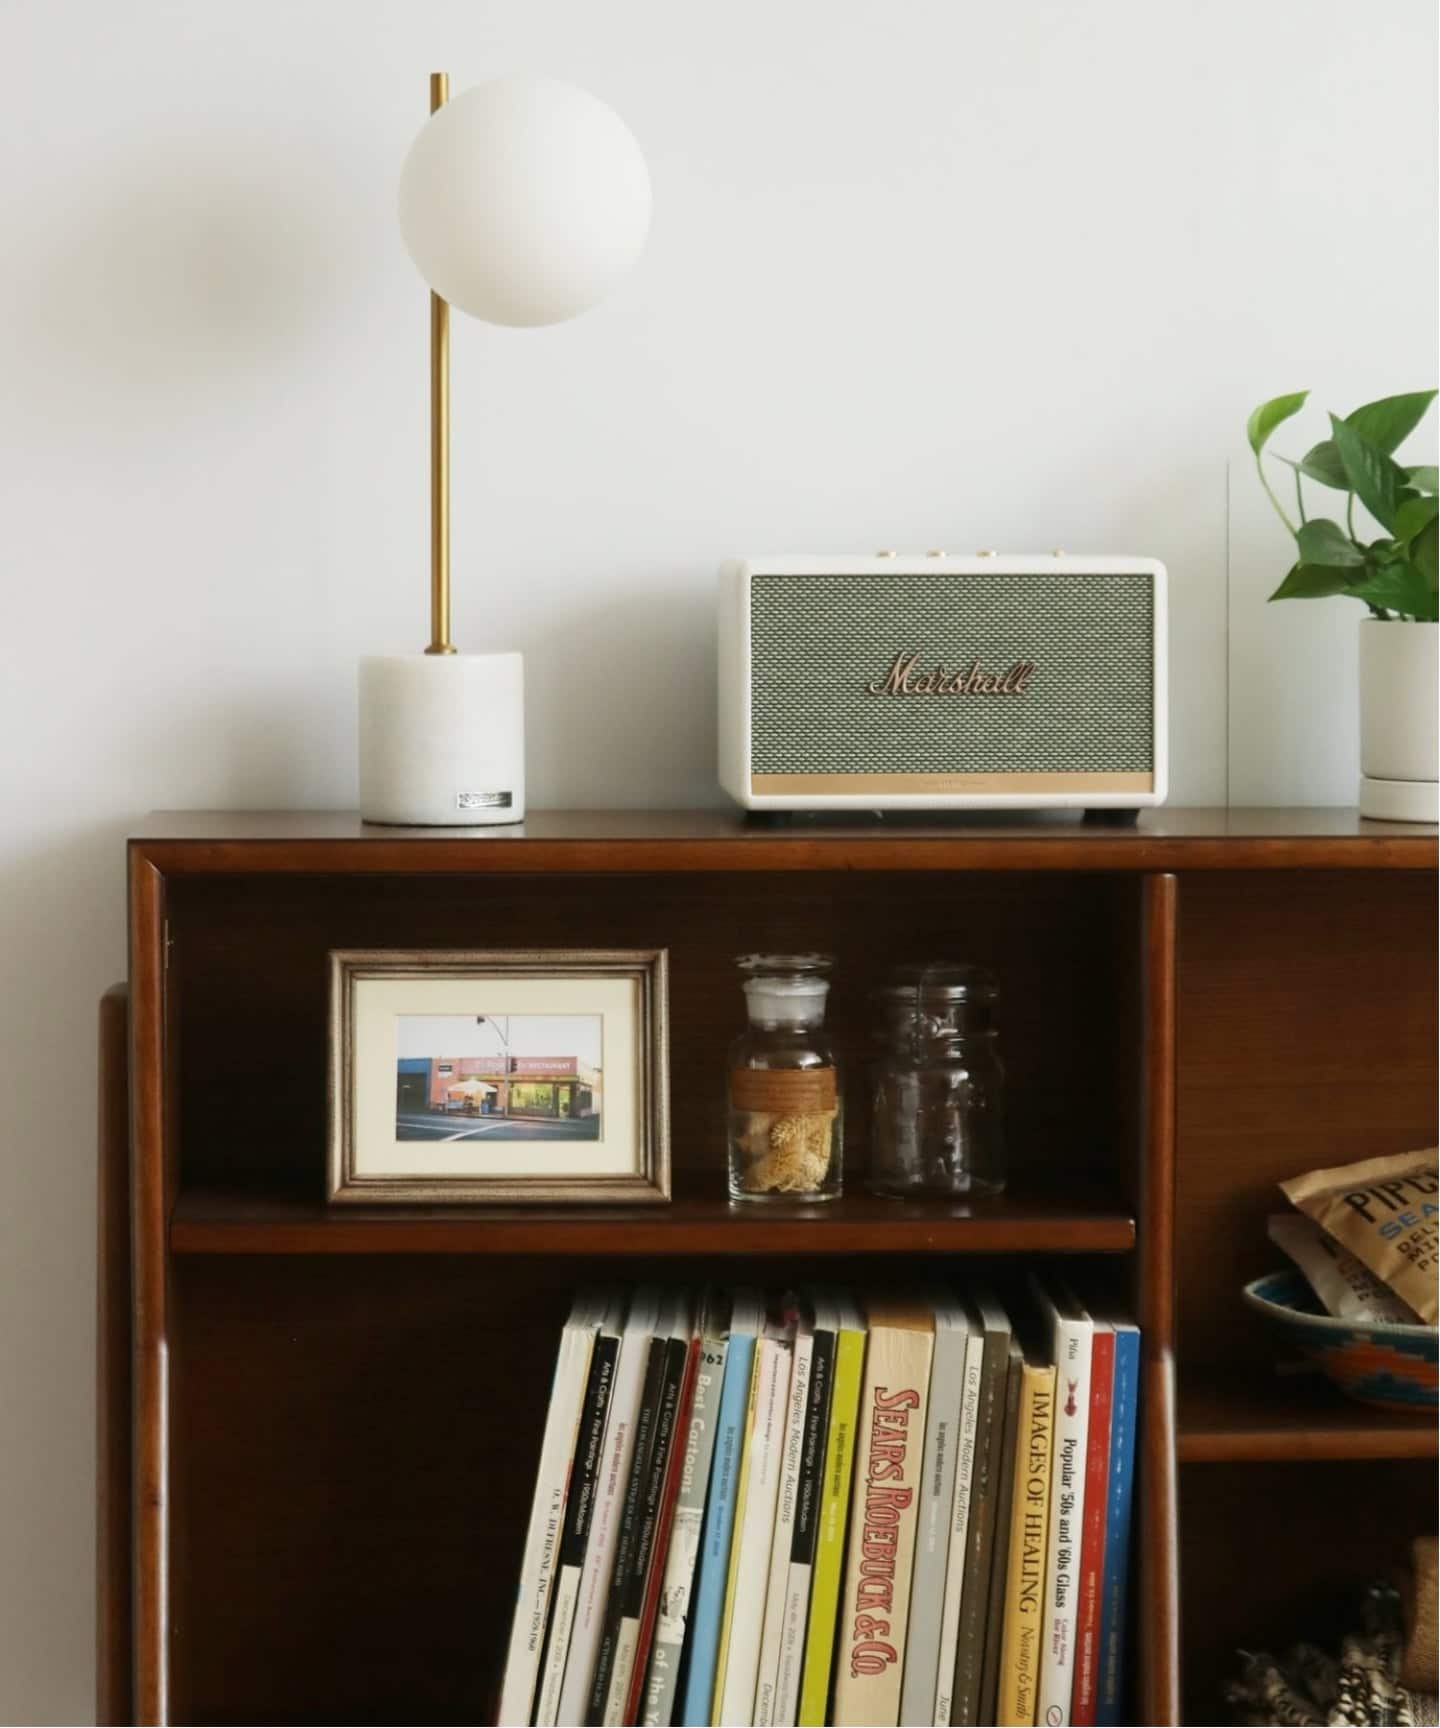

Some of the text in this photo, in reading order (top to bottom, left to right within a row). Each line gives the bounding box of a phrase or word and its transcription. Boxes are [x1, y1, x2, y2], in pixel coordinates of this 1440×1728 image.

[867, 650, 1036, 696] Marshall
[1343, 1170, 1438, 1224] PIPC
[1397, 1221, 1438, 1253] DEL
[601, 1361, 611, 1376] Arts
[796, 1356, 808, 1378] Los
[595, 1384, 607, 1408] Crafts
[666, 1383, 676, 1399] Arts
[693, 1373, 712, 1409] Best
[788, 1379, 805, 1425] Angeles
[591, 1418, 601, 1435] Fine
[659, 1411, 671, 1437] Crafts
[810, 1415, 819, 1429] Fine
[866, 1386, 920, 1483] SEARS,
[1027, 1391, 1049, 1474] IMAGES
[583, 1436, 598, 1470] Paintings
[655, 1446, 665, 1464] Fine
[679, 1416, 705, 1494] Cartoons
[785, 1427, 801, 1471] Modern
[804, 1431, 817, 1467] Paintings
[646, 1466, 661, 1506] Paintings
[780, 1474, 796, 1524] Auctions
[1026, 1477, 1044, 1506] OF
[1055, 1438, 1076, 1608] Popular '50s and '60s Glass
[856, 1486, 913, 1614] ROEBUCK
[937, 1365, 979, 1720] Los Angeles Modern Auctions June
[1018, 1513, 1042, 1613] HEALING
[853, 1614, 890, 1640] &
[653, 1648, 670, 1671] of
[647, 1675, 666, 1705] the
[1018, 1673, 1032, 1684] &
[1015, 1686, 1031, 1718] Smith
